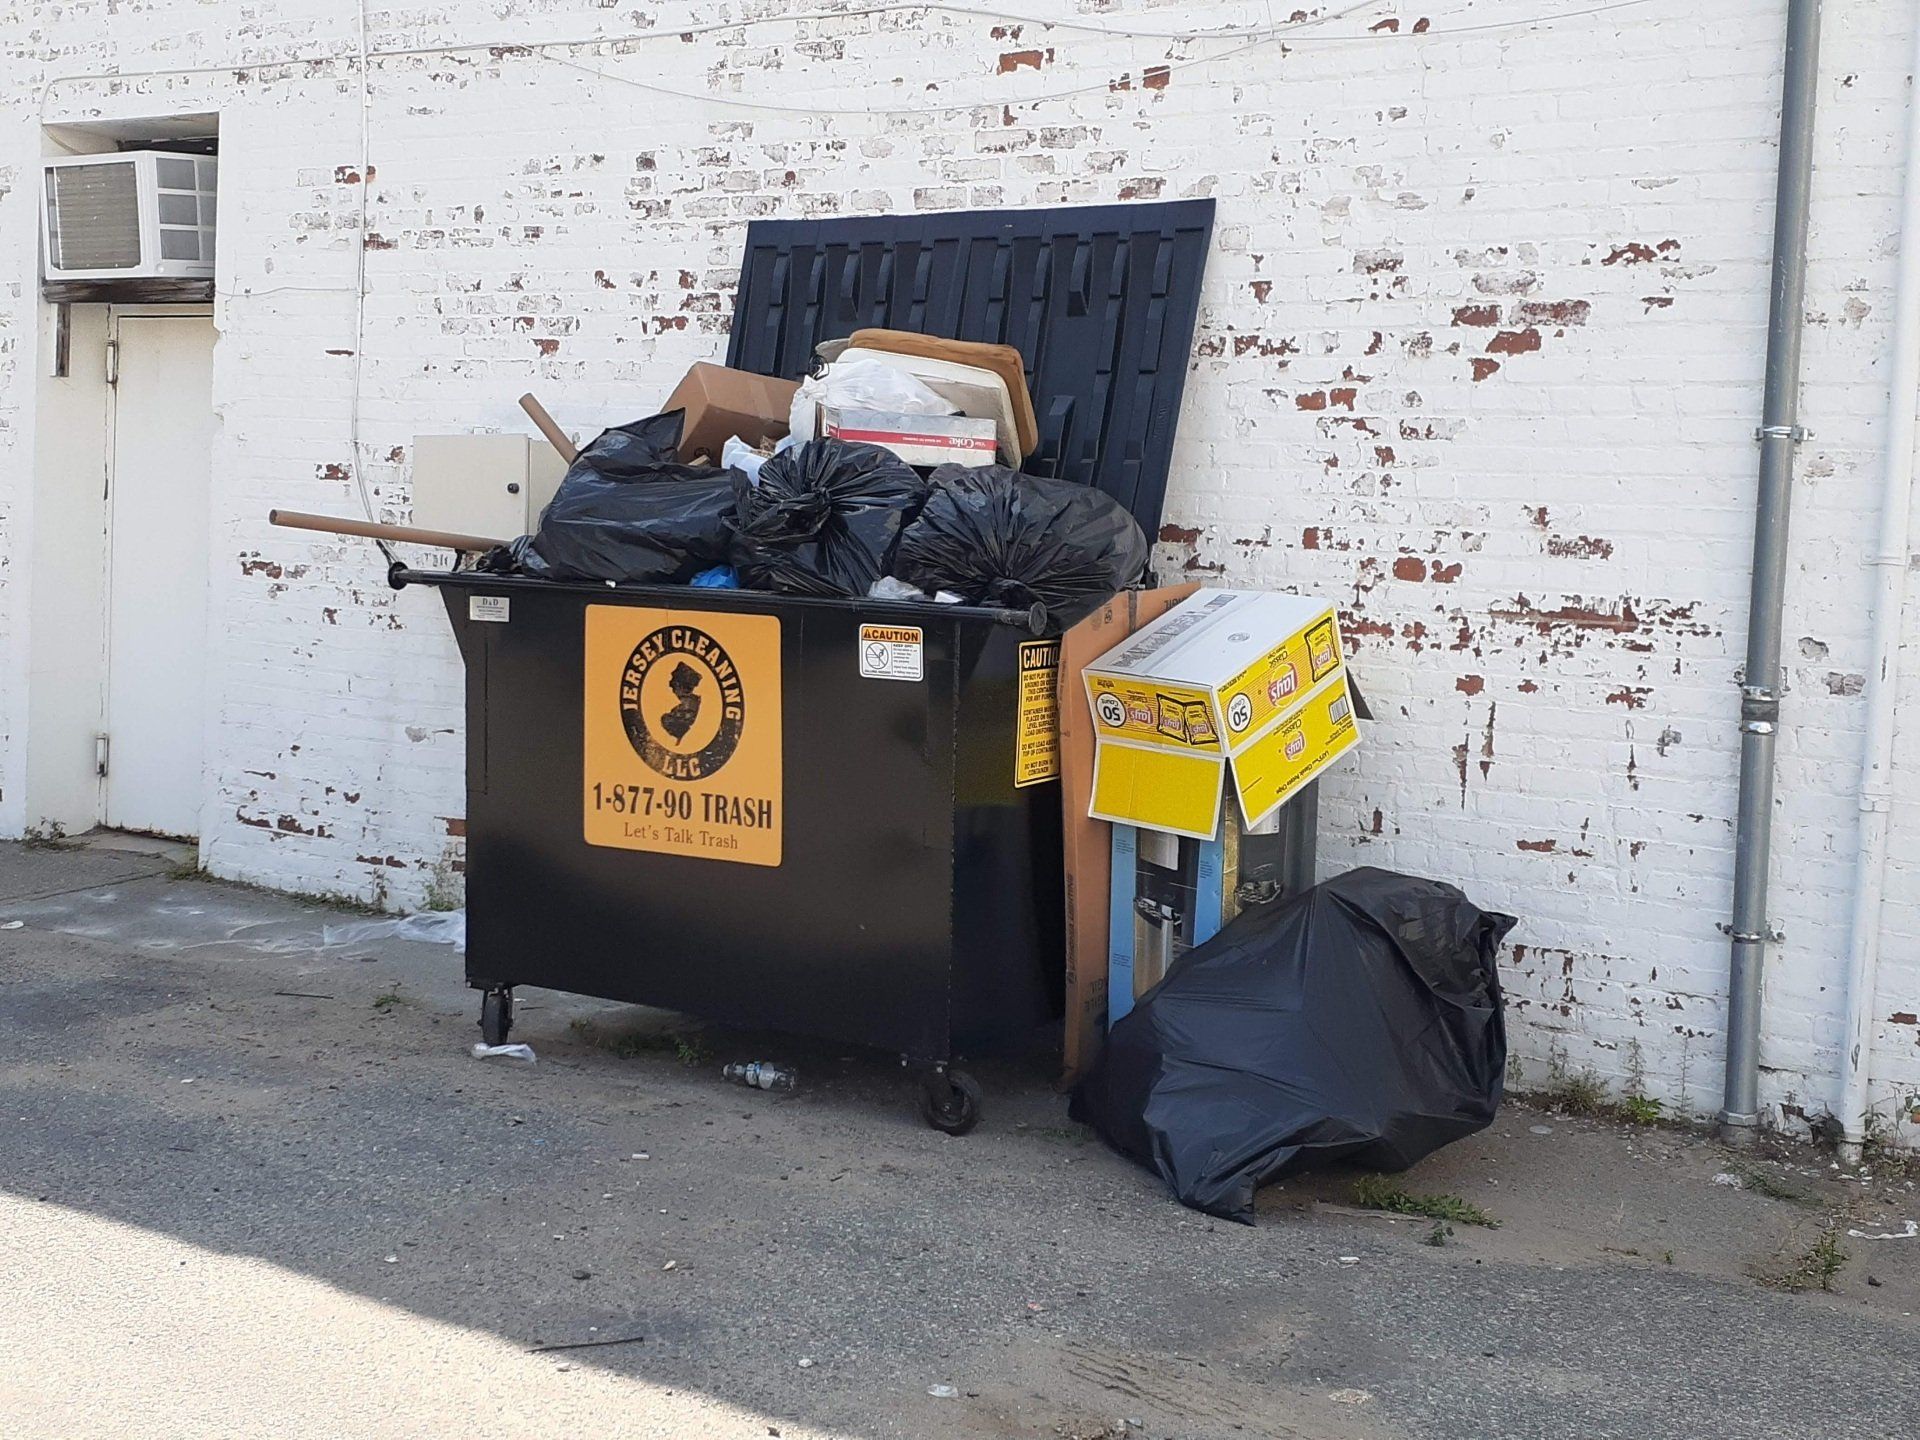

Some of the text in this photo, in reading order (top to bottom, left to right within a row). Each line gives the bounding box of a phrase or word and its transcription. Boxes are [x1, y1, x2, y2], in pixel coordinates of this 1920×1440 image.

[949, 438, 974, 448] Coke
[872, 629, 918, 642] CAUTION
[1024, 647, 1059, 668] CAUTIO
[623, 629, 742, 721] JERSEY CLEANING
[1101, 698, 1119, 707] Count
[1103, 706, 1120, 720] 50
[1233, 706, 1248, 726] 50
[662, 755, 701, 777] LLC
[593, 782, 772, 829] 1-877-90 TRASH
[624, 822, 738, 849] Let's Talk Trash
